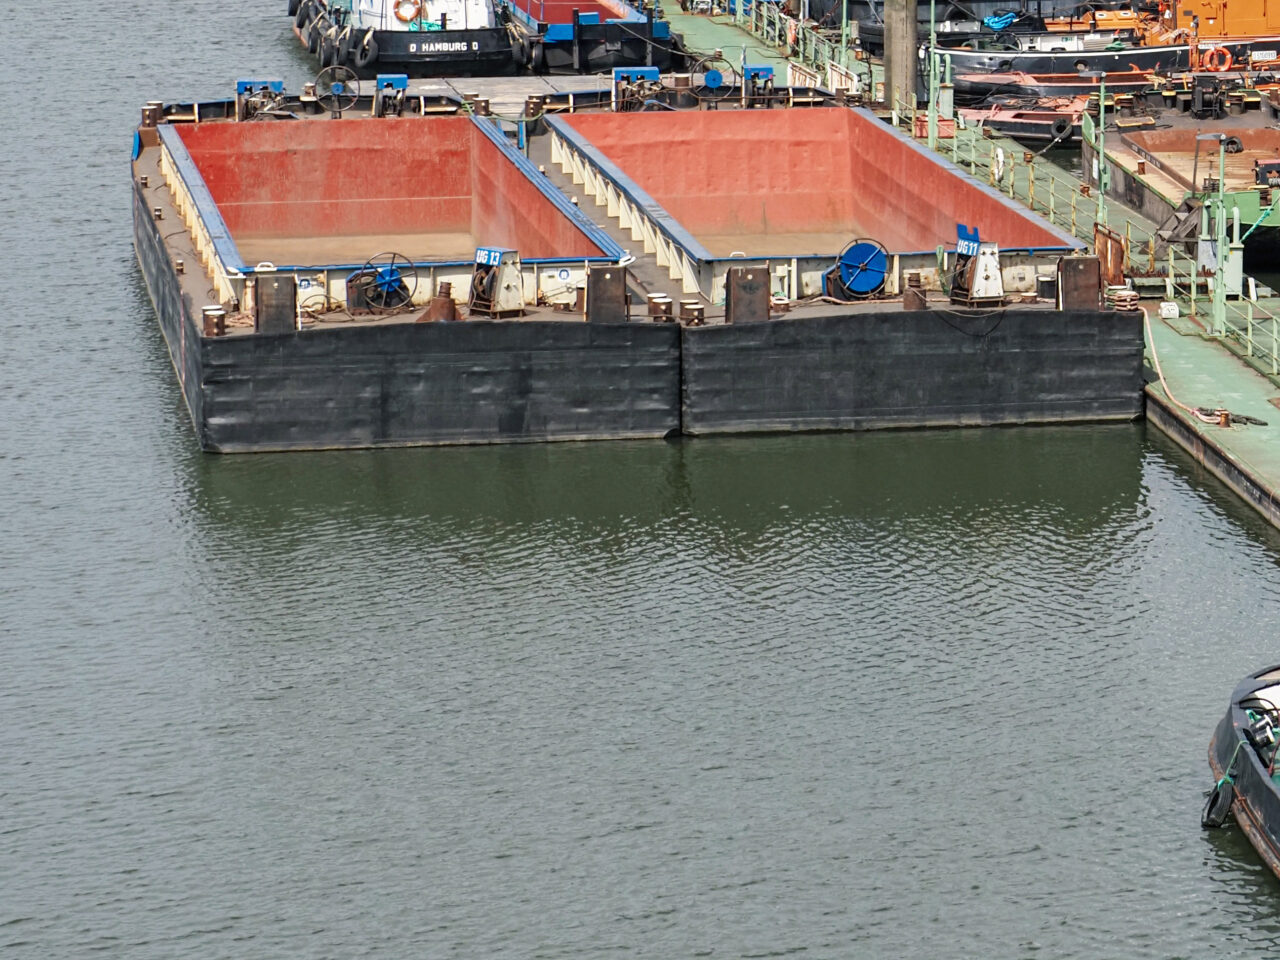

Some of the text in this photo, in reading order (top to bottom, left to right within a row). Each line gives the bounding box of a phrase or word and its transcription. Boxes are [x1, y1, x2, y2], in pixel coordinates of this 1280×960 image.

[422, 42, 467, 51] HAMBURG
[957, 240, 978, 256] UG 11
[476, 250, 500, 265] UG 13
